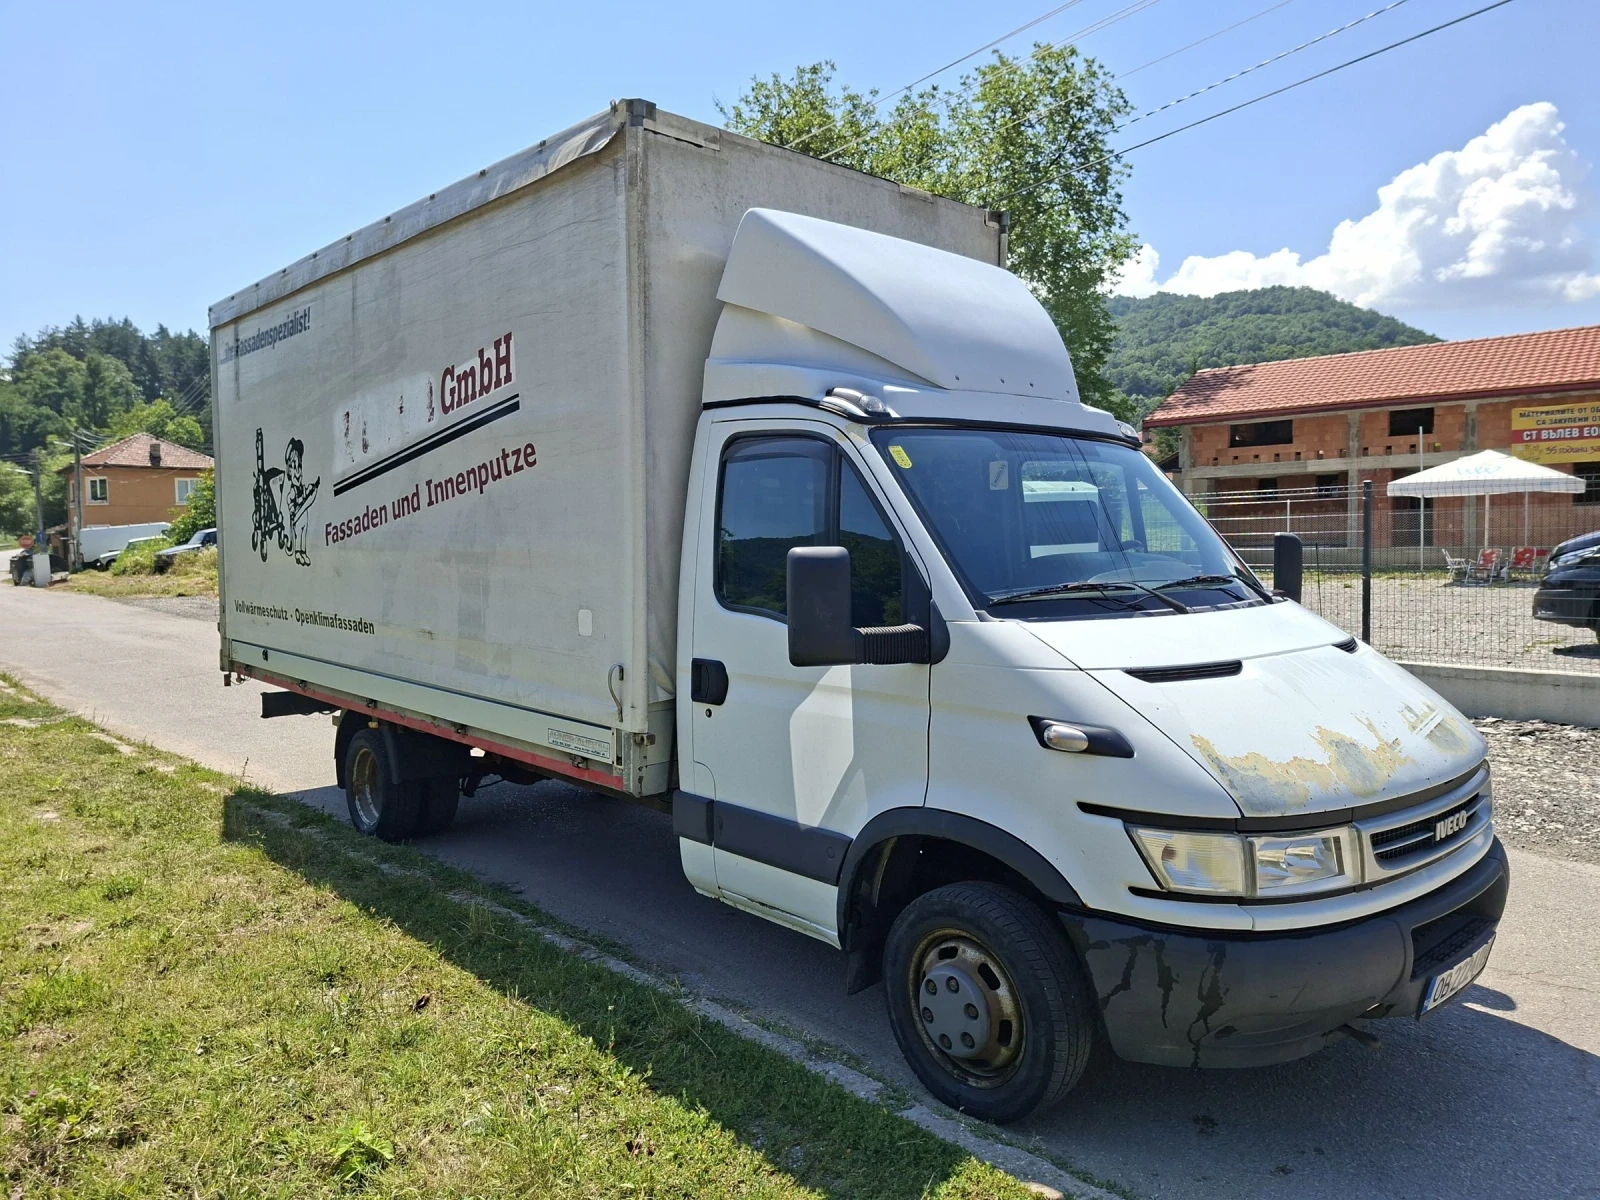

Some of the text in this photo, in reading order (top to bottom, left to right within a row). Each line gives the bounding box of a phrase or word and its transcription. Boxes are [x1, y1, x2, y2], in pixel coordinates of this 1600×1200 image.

[441, 332, 513, 415] GmbH
[1519, 408, 1575, 418] МАТЕРИАЛИТЕ
[1549, 416, 1589, 425] ЗАКУПЕНИ
[1541, 427, 1580, 440] ВЪЛЕВ
[1583, 426, 1600, 437] ЕО
[1558, 445, 1588, 454] години
[325, 443, 538, 546] Fassaden und Innenputze
[234, 599, 289, 620] Vollwärmeschutz
[295, 608, 375, 635] Openklimafassaden
[1435, 810, 1467, 841] IVECO
